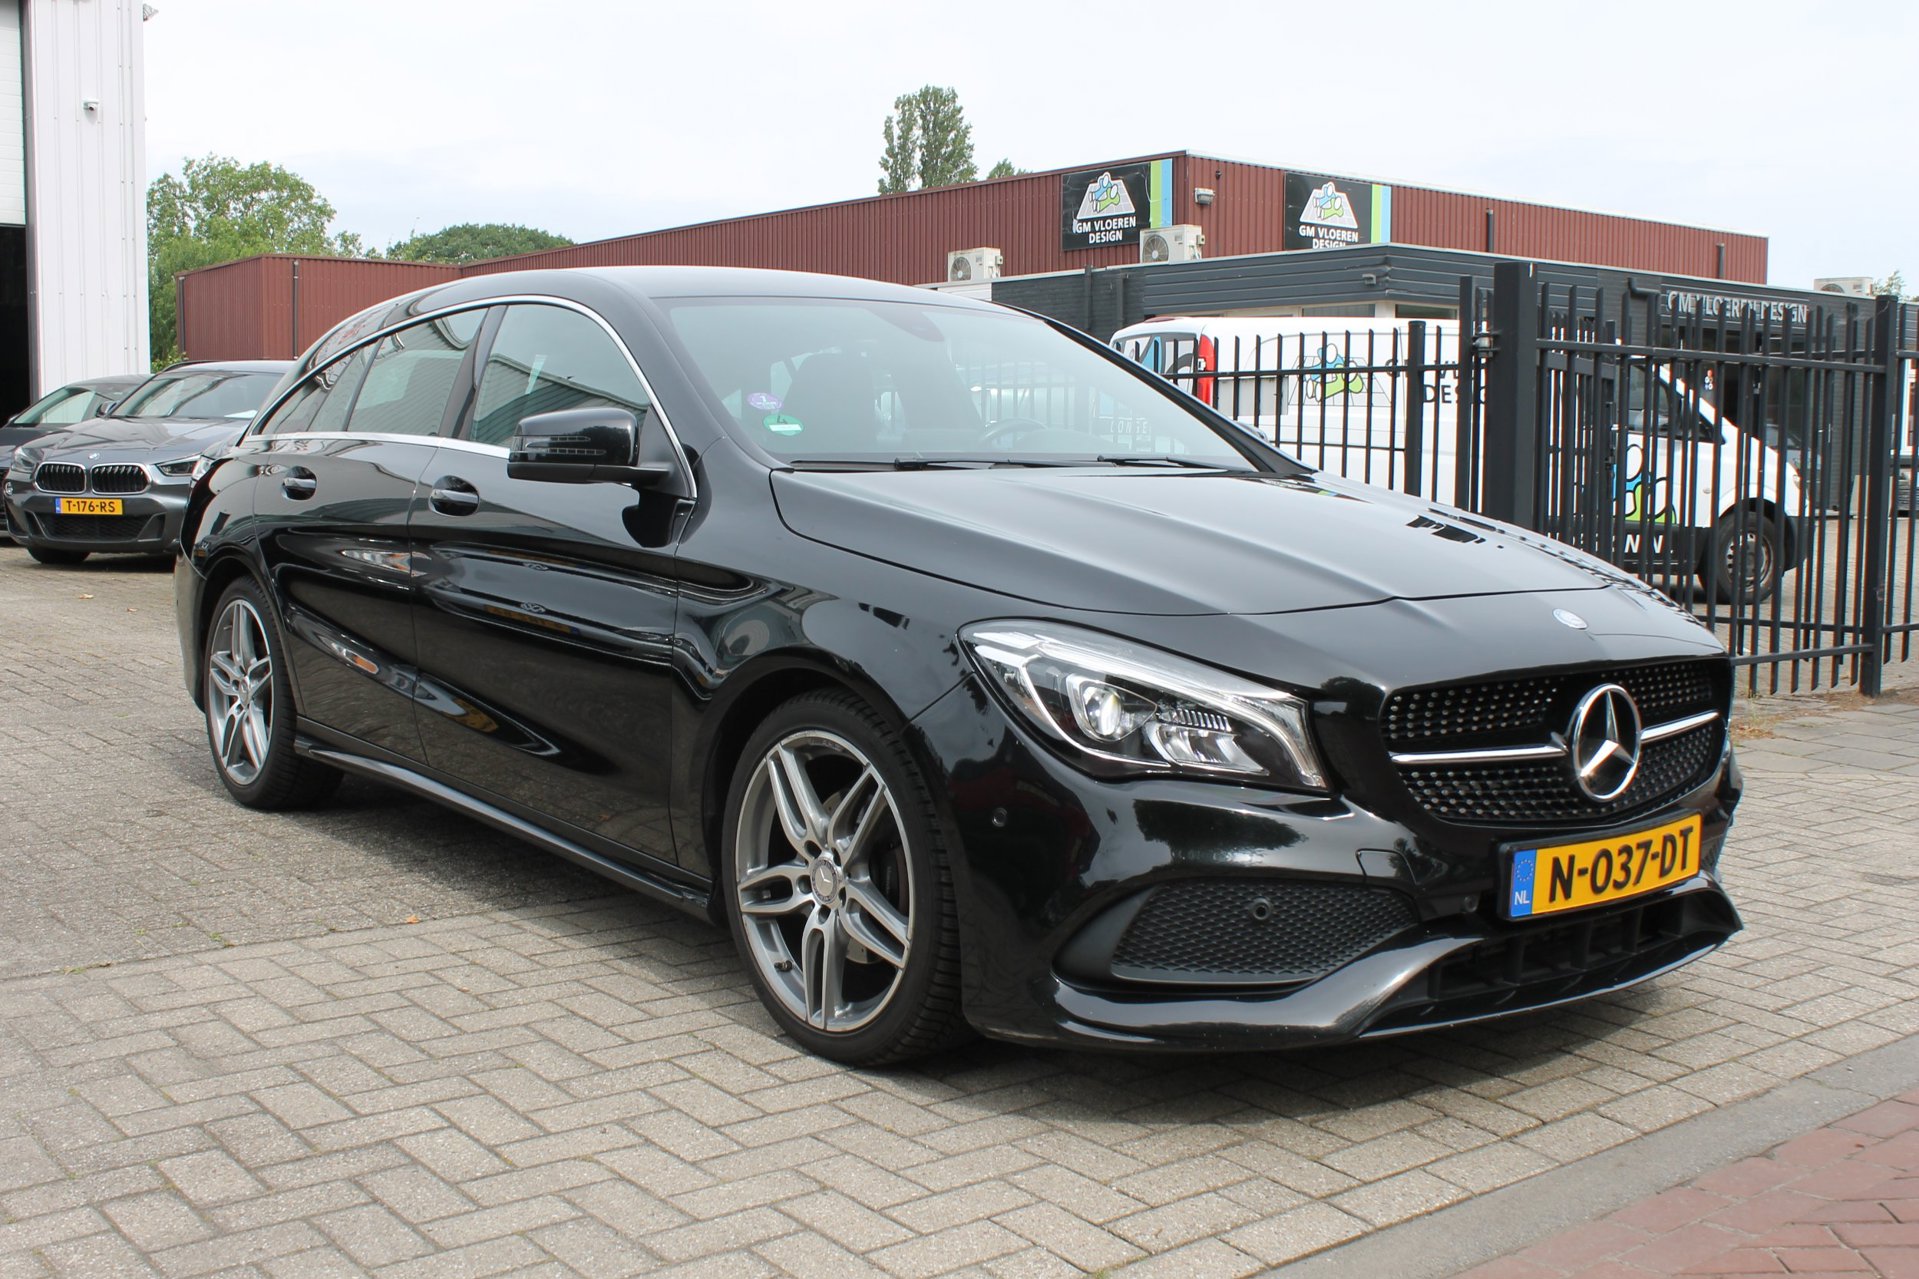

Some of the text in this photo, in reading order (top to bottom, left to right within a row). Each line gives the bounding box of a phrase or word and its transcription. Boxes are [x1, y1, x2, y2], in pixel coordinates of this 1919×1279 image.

[1076, 216, 1136, 233] GM VLOEREN
[1088, 229, 1123, 244] DESIGN
[1299, 225, 1359, 243] GM VLOEREN
[1760, 300, 1808, 323] DESGN
[66, 500, 115, 513] T-176-RS
[1548, 825, 1694, 903] N-037-DT
[1514, 890, 1530, 905] NL
